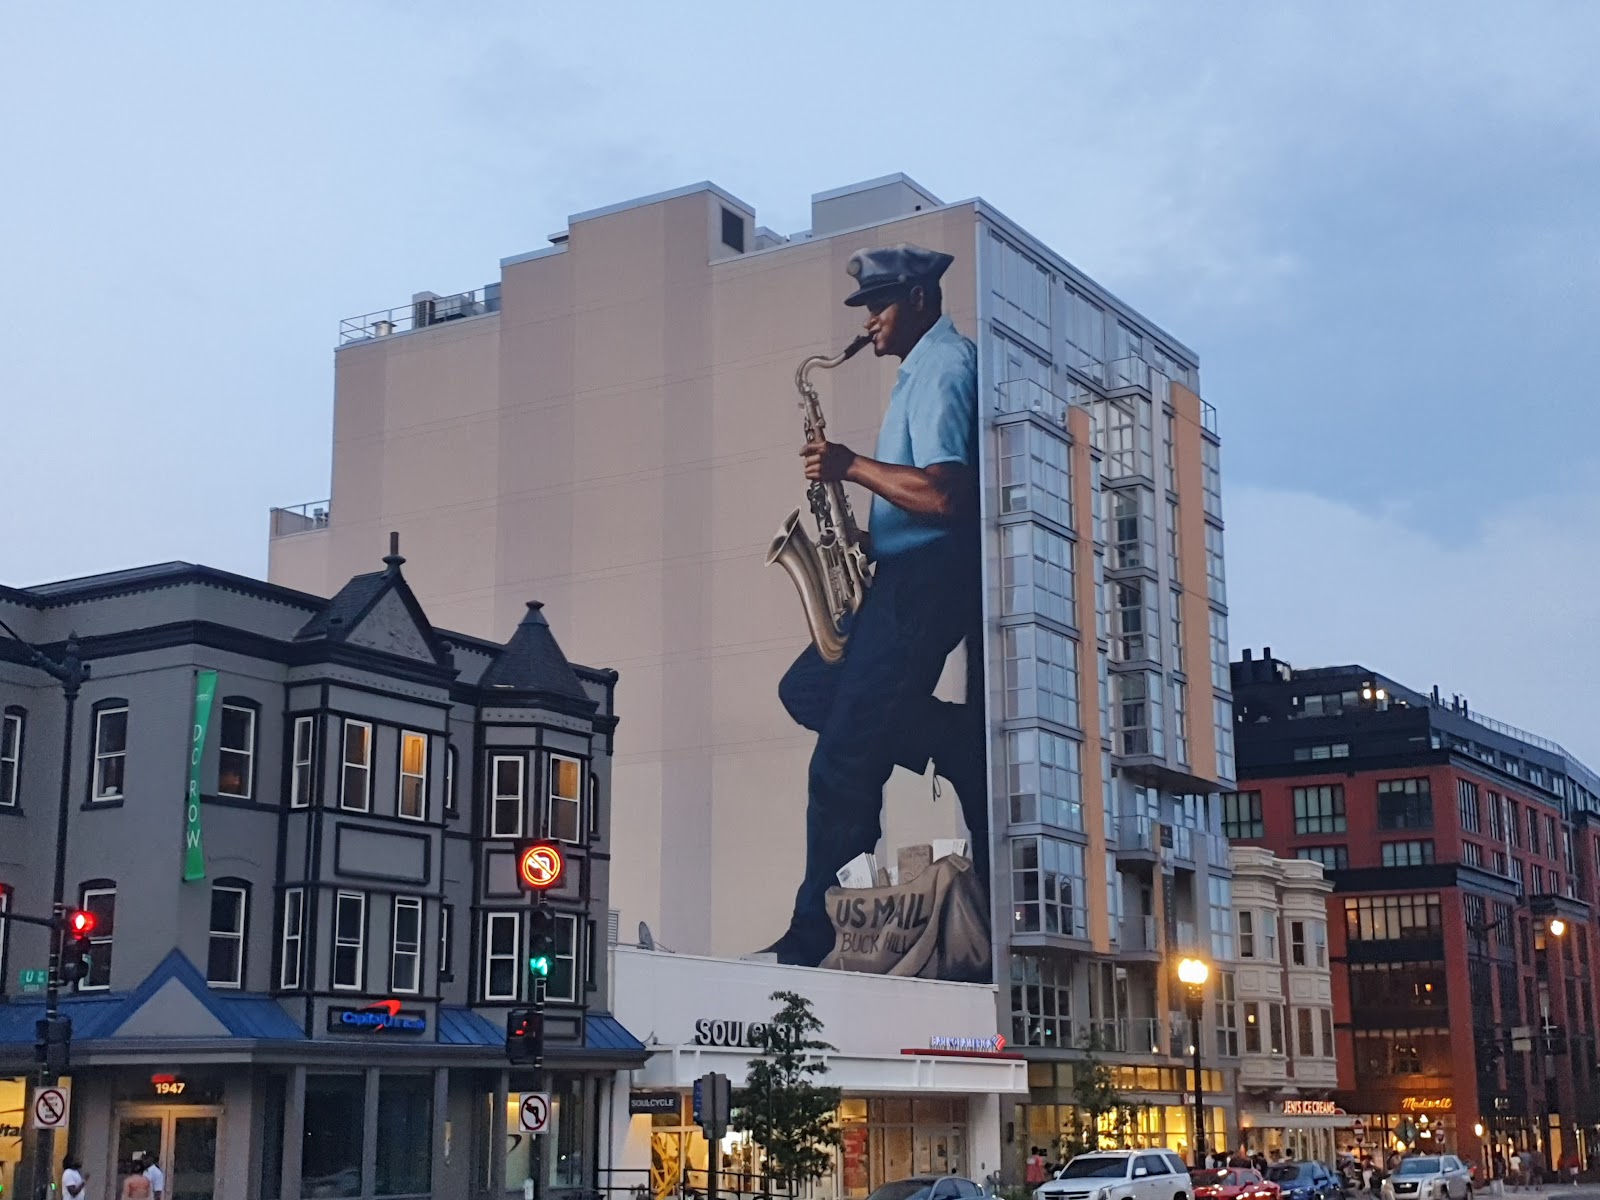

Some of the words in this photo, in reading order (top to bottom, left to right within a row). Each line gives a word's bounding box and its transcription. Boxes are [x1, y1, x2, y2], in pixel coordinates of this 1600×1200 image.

[191, 724, 202, 765] DC
[186, 780, 200, 848] ROW
[835, 897, 867, 928] US
[872, 893, 930, 930] MAIL
[840, 932, 879, 954] BUCK
[884, 931, 913, 954] HILL
[25, 970, 34, 982] U
[155, 1082, 186, 1094] 1947
[631, 1098, 674, 1107] SOULCYCLE
